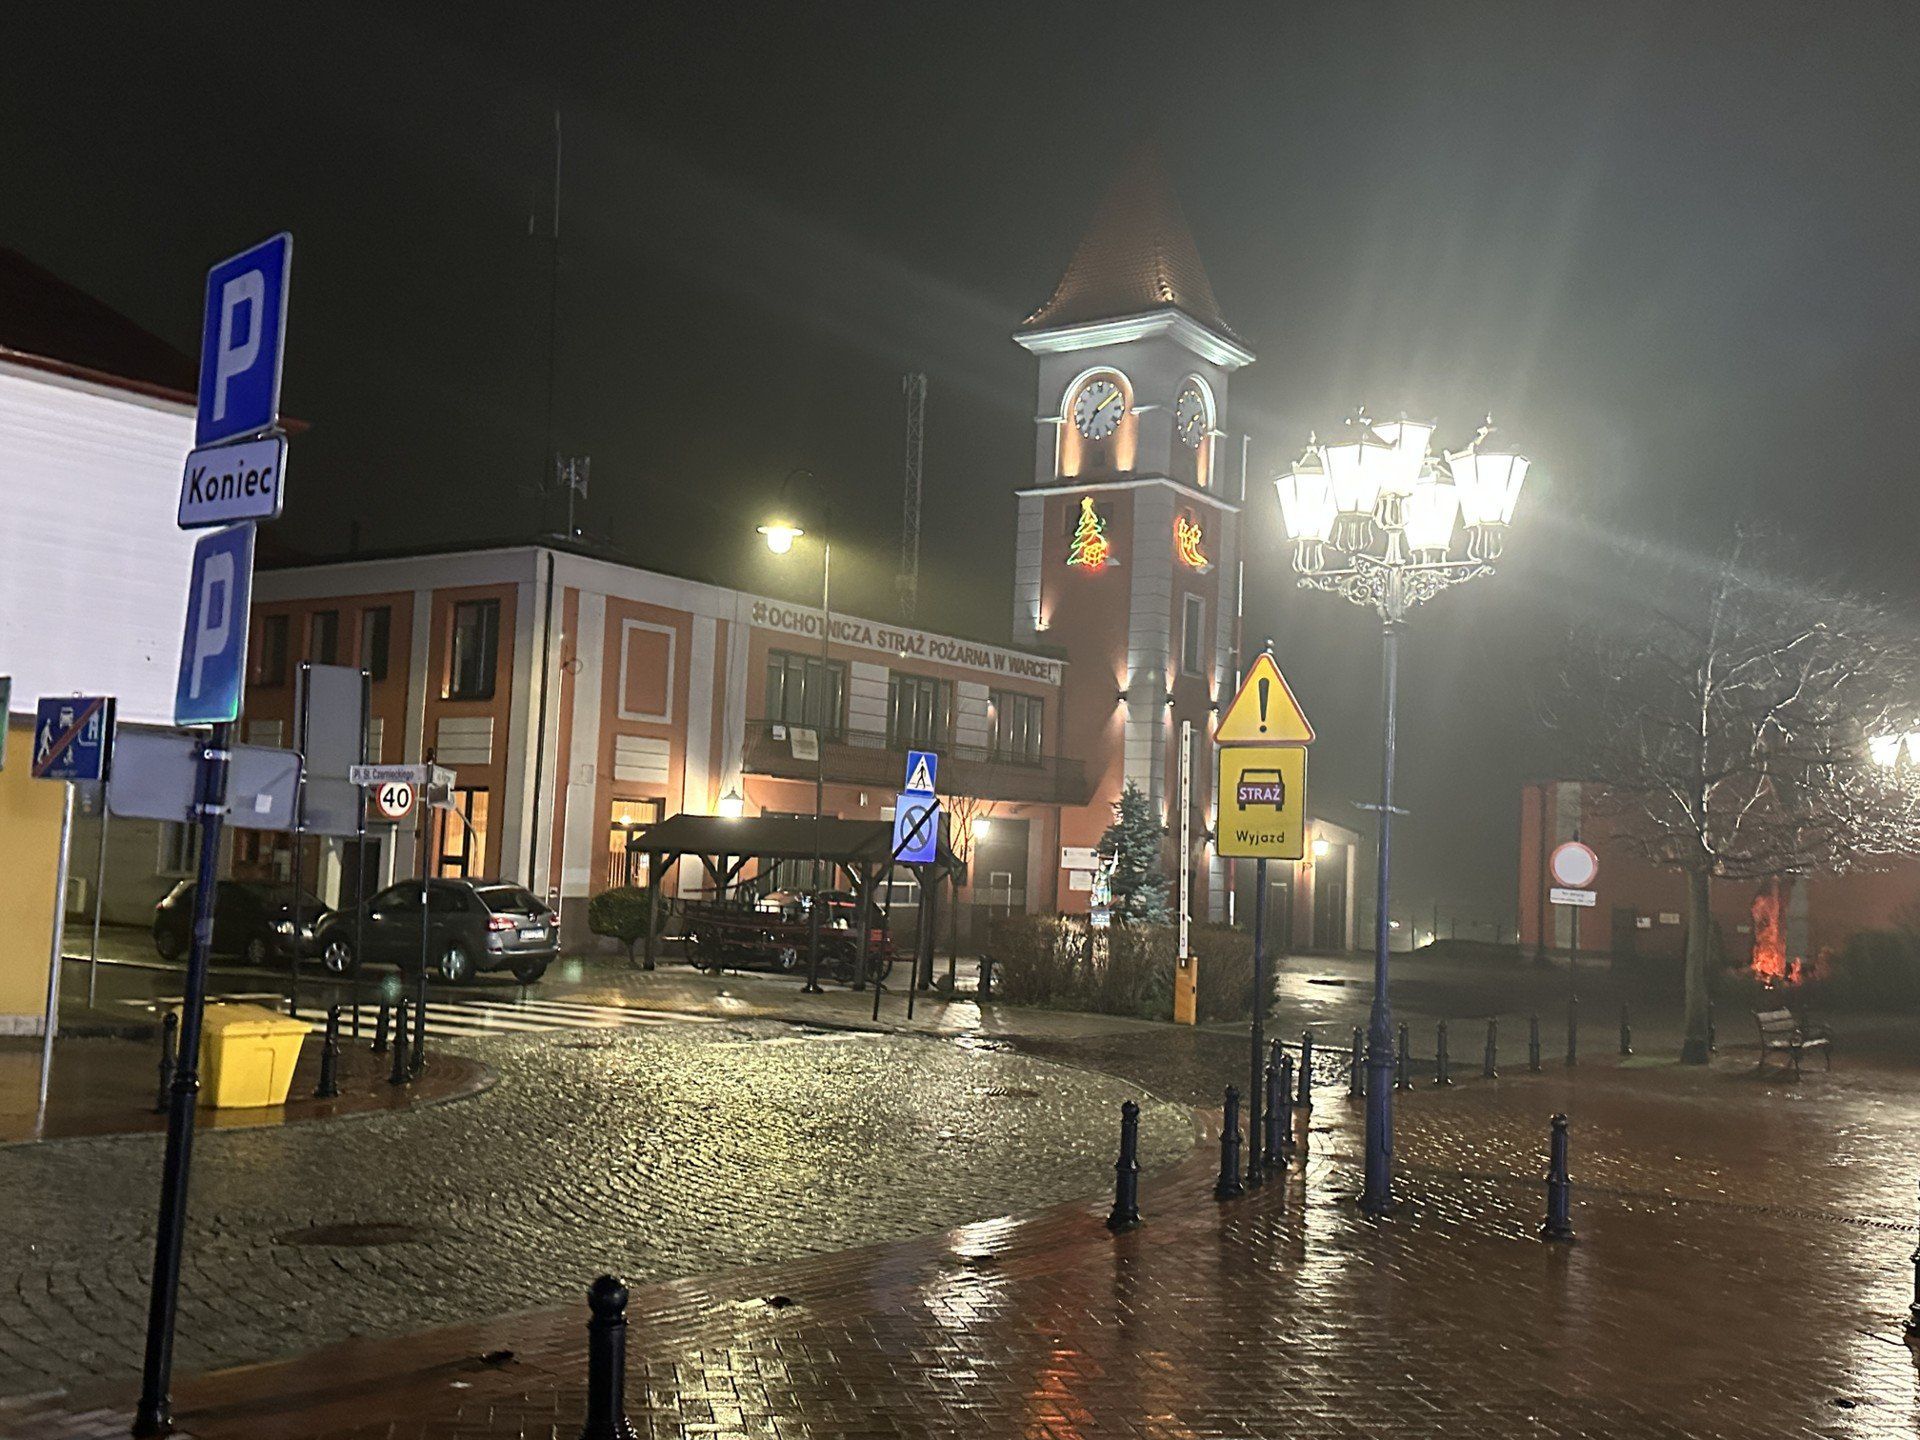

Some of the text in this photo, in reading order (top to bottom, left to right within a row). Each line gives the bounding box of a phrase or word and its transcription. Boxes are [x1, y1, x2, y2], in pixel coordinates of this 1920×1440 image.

[212, 268, 265, 422] P
[189, 459, 272, 504] Koniec
[189, 551, 235, 700] P
[768, 606, 874, 646] OCHOTNICZA
[876, 629, 926, 656] STRAŻ
[928, 640, 992, 669] POŻARNA
[993, 652, 1006, 671] W
[382, 787, 409, 808] 40
[1239, 784, 1281, 801] STRAŻ
[1236, 830, 1285, 846] Wyjazd
